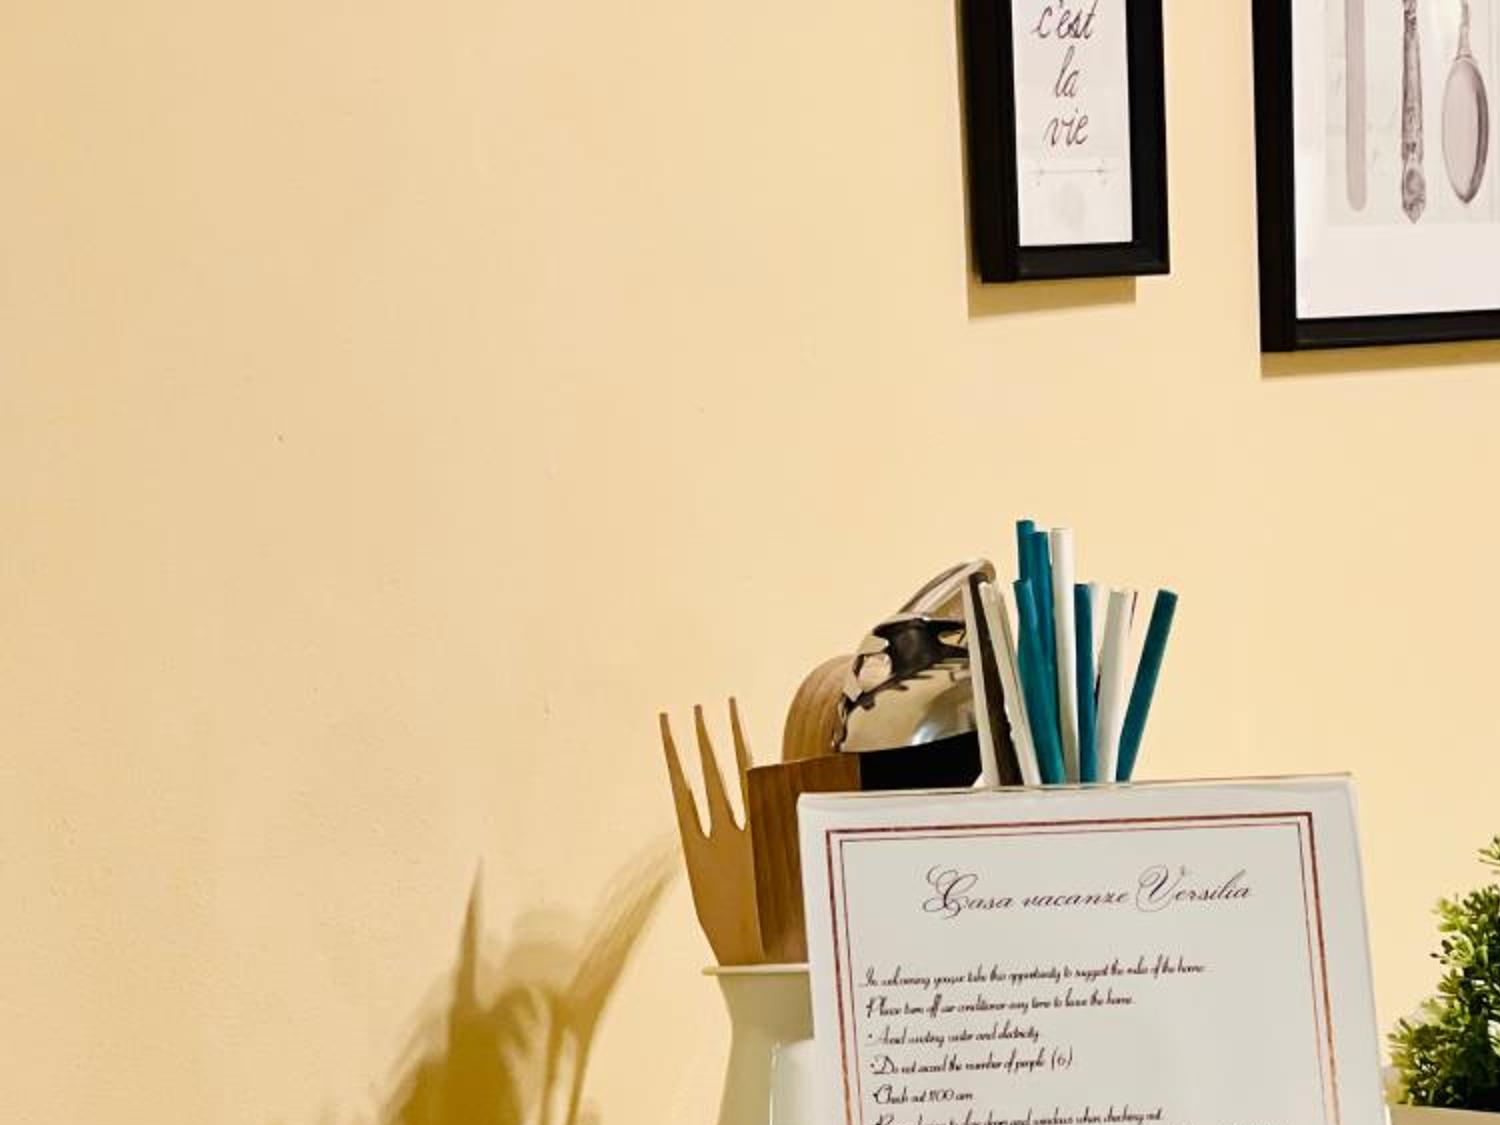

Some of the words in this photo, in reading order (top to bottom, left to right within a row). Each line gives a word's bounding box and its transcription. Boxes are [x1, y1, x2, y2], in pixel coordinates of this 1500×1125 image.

[1055, 45, 1079, 98] la
[1043, 107, 1089, 147] vie
[922, 864, 1013, 919] Casa
[1021, 890, 1130, 909] vacanze
[1137, 863, 1250, 913] Versilia
[1063, 964, 1072, 979] to
[1110, 957, 1124, 976] the
[1053, 995, 1062, 1009] to
[1089, 987, 1104, 1007] the
